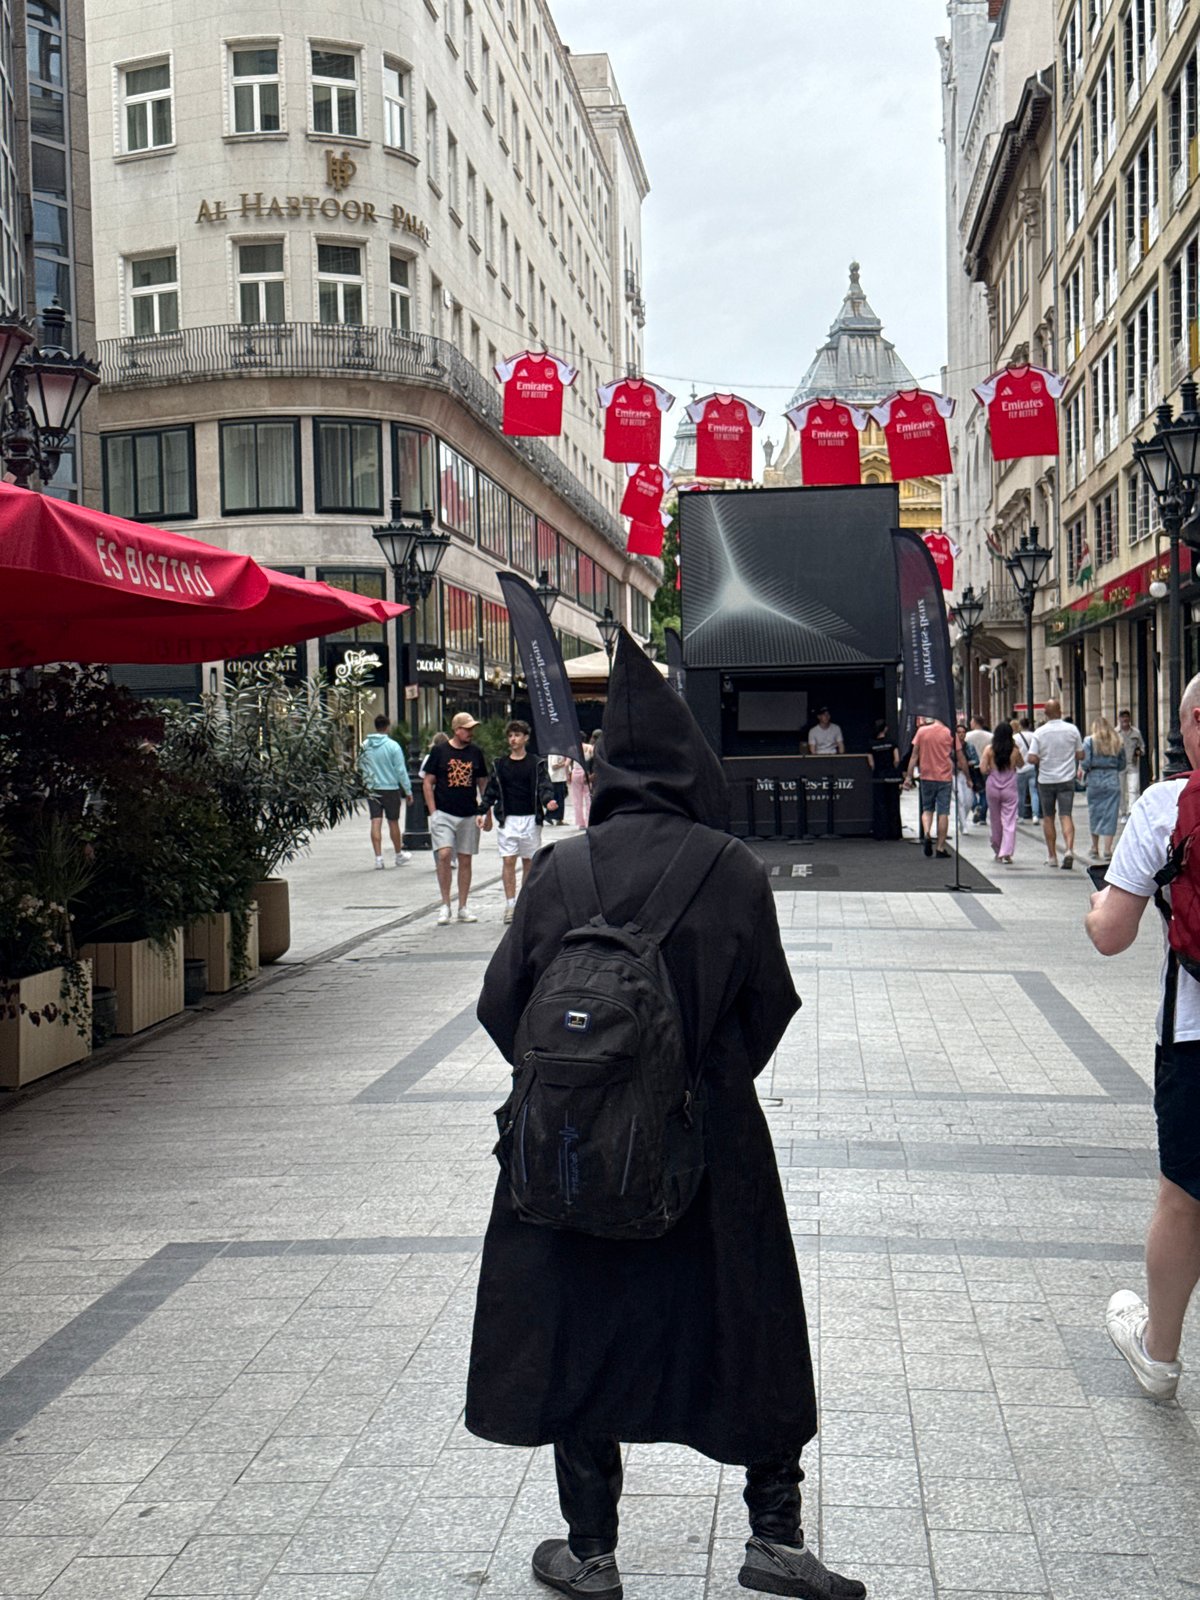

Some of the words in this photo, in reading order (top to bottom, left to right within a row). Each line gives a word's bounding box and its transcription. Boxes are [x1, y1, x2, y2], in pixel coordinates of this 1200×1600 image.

[239, 192, 378, 223] HABTOOR
[516, 381, 554, 391] Emirates
[1001, 398, 1044, 412] Emirates
[615, 408, 651, 419] Emirates
[707, 423, 744, 434] Emirates
[895, 419, 935, 433] Emirates
[811, 429, 849, 440] Emirates
[96, 531, 124, 580] ÉS
[125, 546, 215, 597] BISZTRÓ
[227, 658, 297, 673] CHOCOATE
